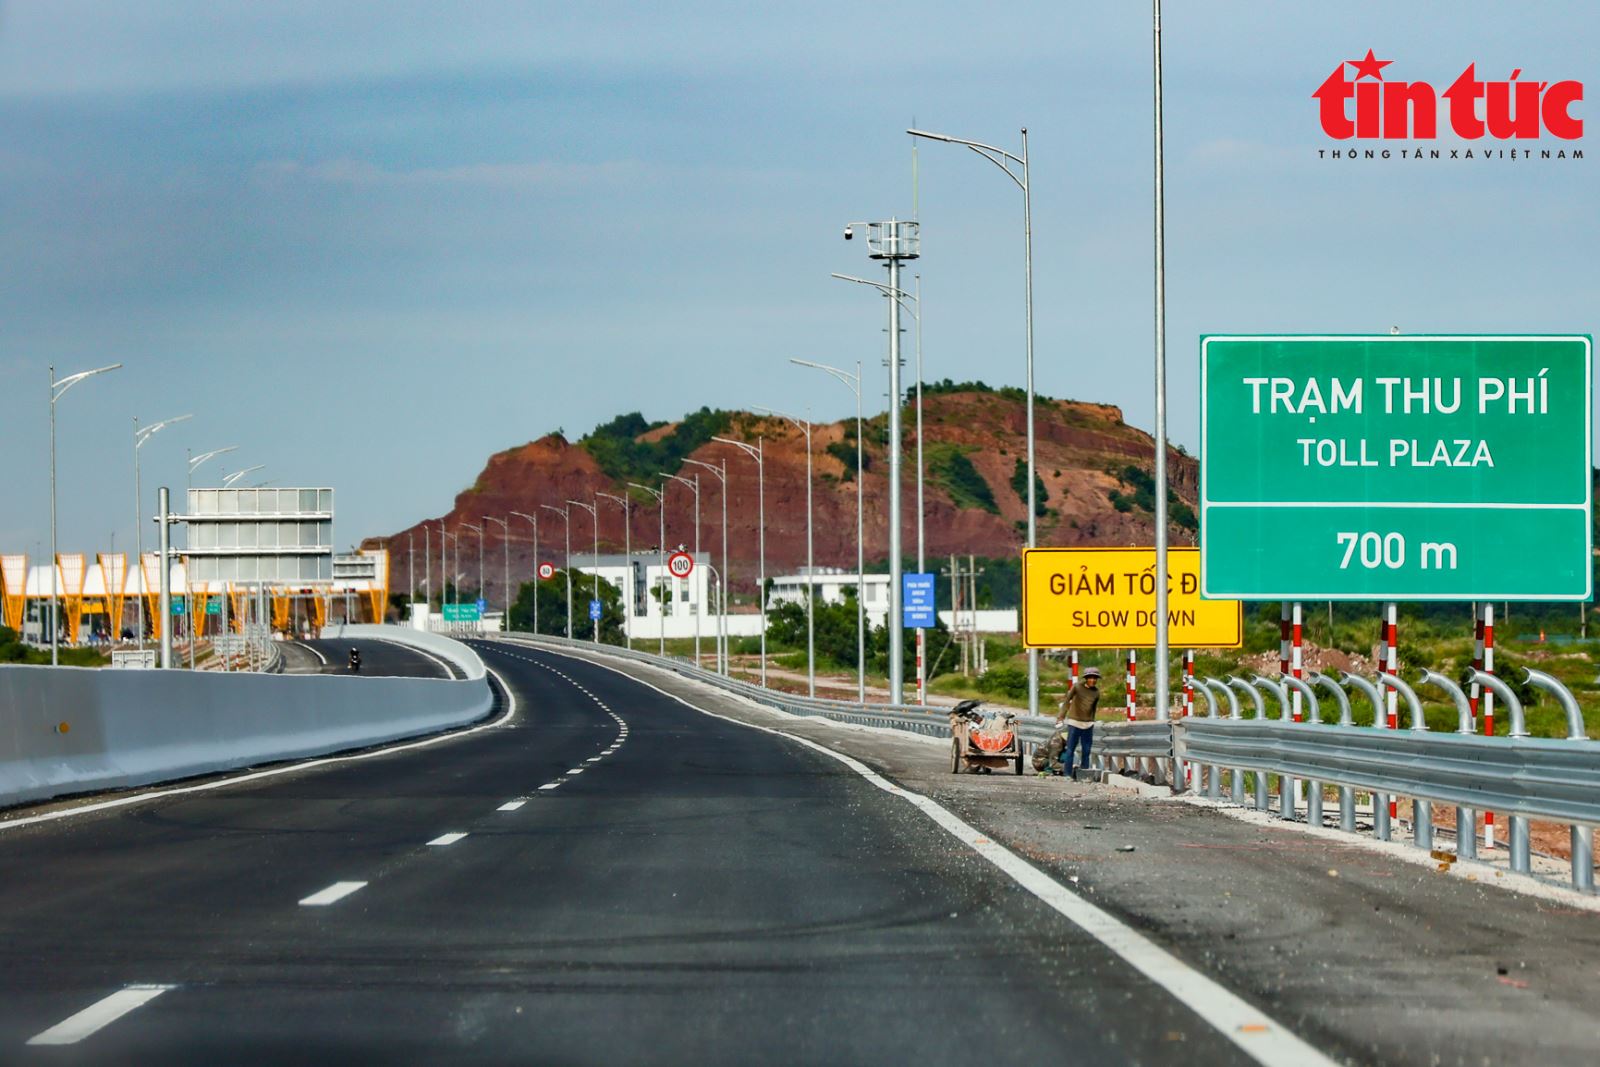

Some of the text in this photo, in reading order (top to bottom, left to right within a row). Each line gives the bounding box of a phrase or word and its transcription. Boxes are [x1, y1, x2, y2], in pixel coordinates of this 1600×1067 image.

[1243, 368, 1549, 423] TRẠM THU PHÍ
[1297, 438, 1494, 467] TOLL PLAZA
[1336, 531, 1457, 569] 700 m
[673, 559, 688, 571] 100
[1050, 565, 1114, 595] GIẢM
[1180, 573, 1198, 595] Đ
[1072, 610, 1129, 627] SLOW
